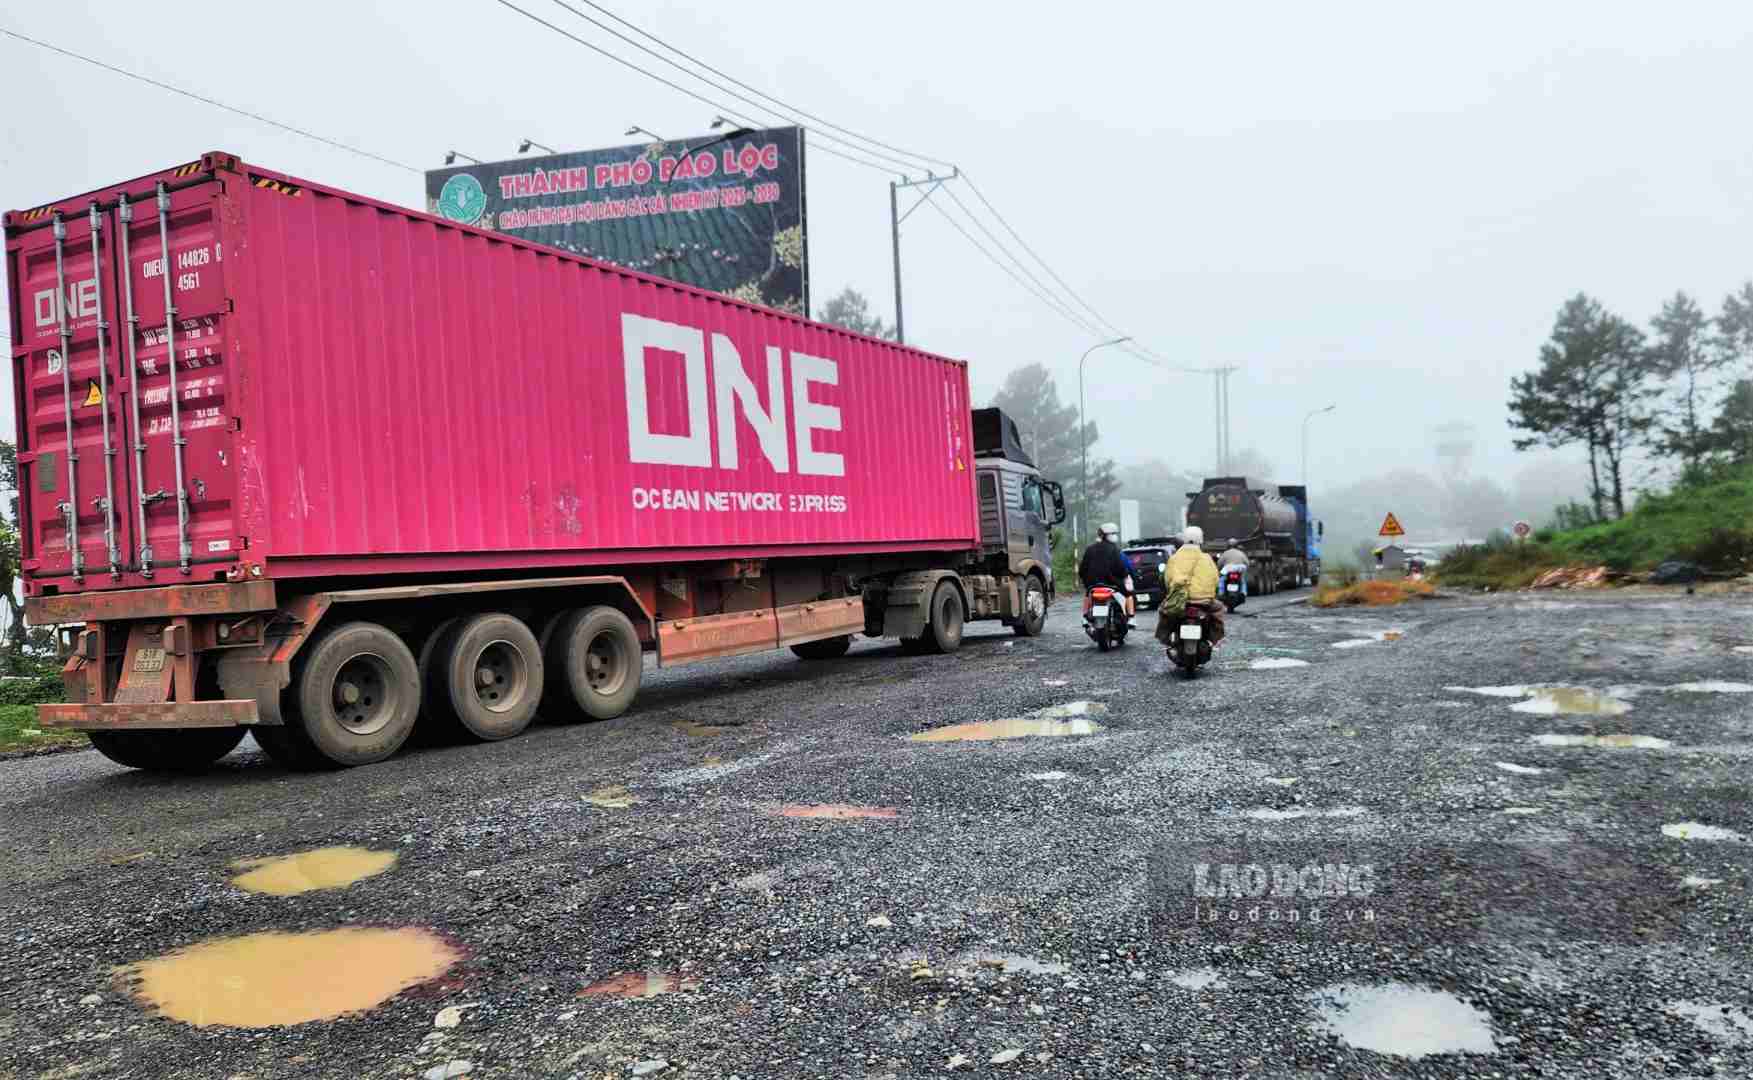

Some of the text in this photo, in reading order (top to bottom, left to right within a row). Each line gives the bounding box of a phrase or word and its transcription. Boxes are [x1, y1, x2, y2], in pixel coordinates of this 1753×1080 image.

[499, 167, 588, 199] THÀNH
[595, 152, 652, 189] PHỐ
[723, 141, 778, 177] LỘC
[178, 247, 209, 270] 144826
[178, 271, 200, 291] 45G1
[34, 278, 97, 328] ONE
[621, 312, 844, 476] ONE
[632, 487, 847, 513] OCEAN NETWORK EXPRESS
